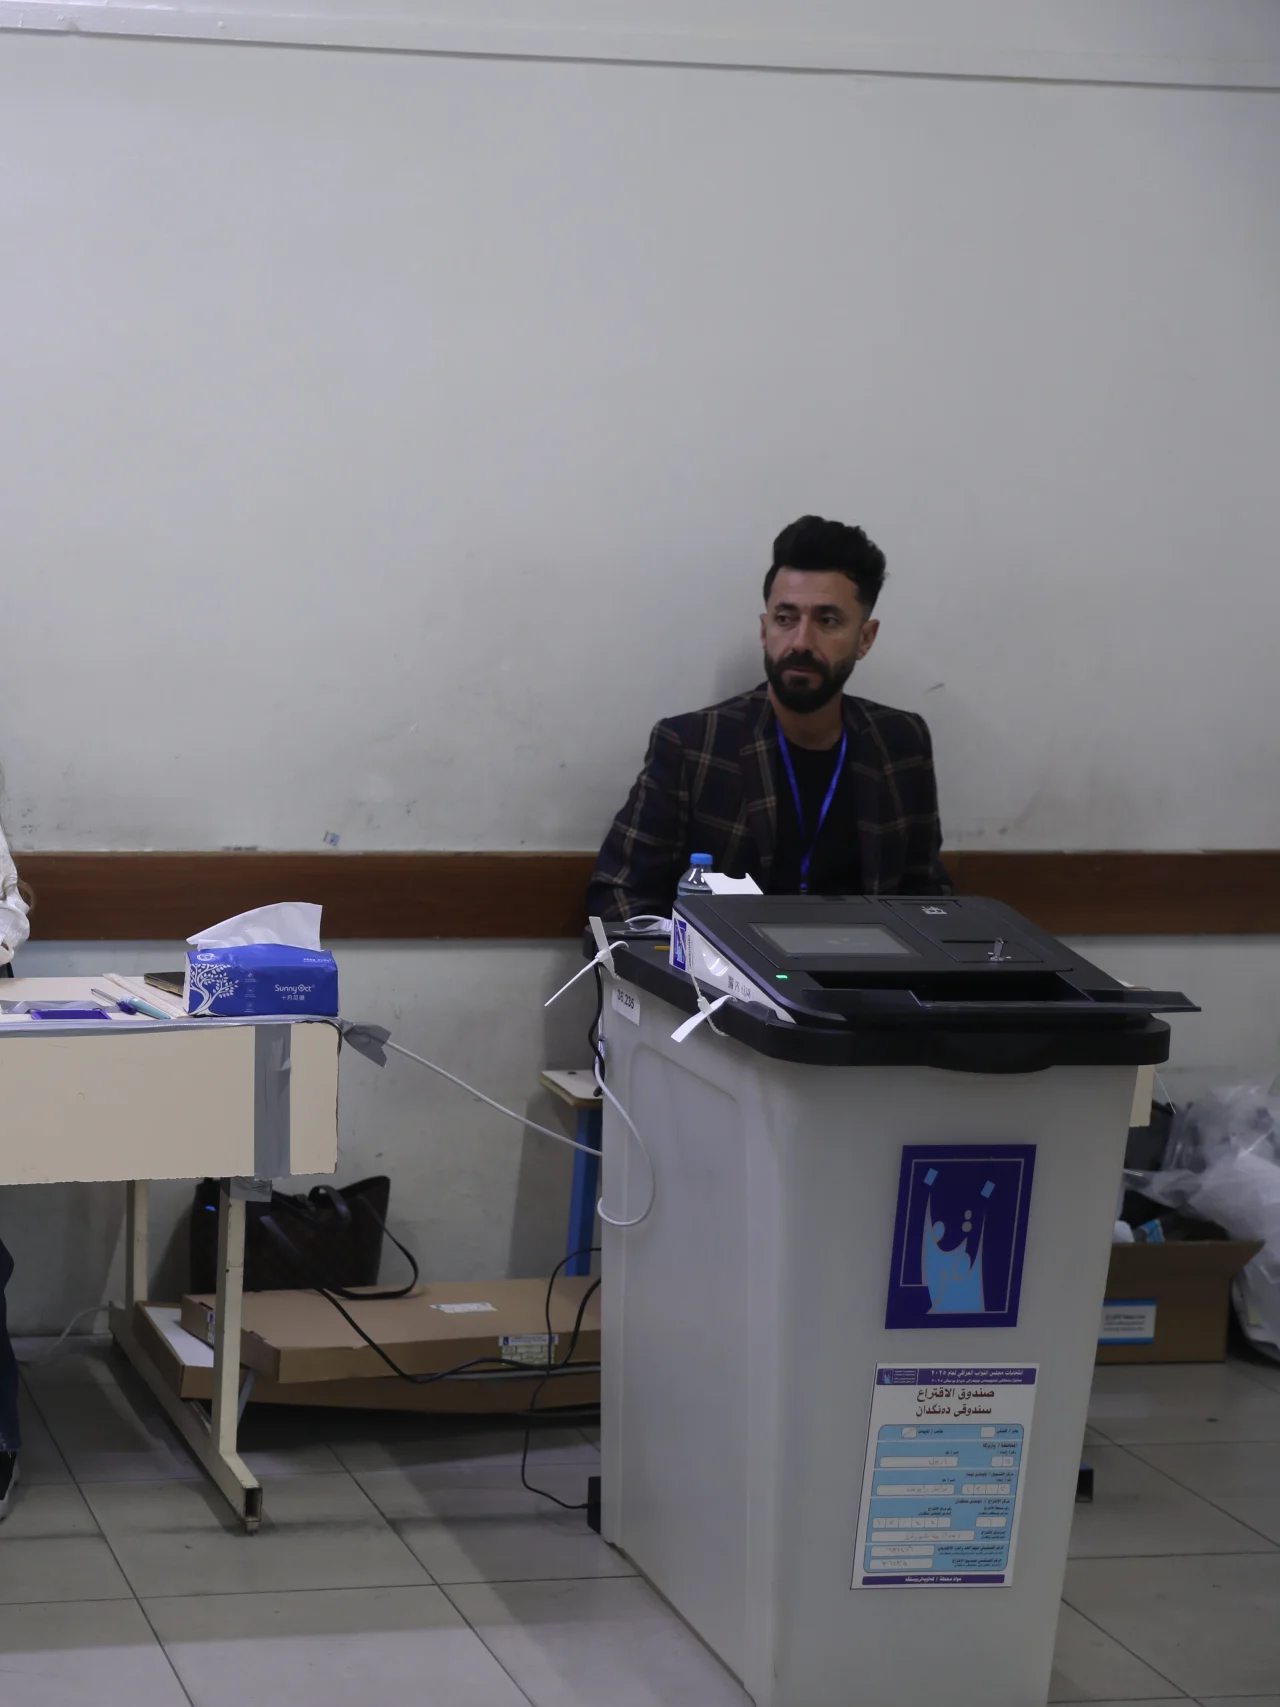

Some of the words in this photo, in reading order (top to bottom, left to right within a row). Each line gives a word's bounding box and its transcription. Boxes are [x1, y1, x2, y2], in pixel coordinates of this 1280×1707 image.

[274, 984, 312, 995] SunnyOct
[916, 1387, 955, 1402] الاقتراع
[957, 1388, 995, 1400] صندوق
